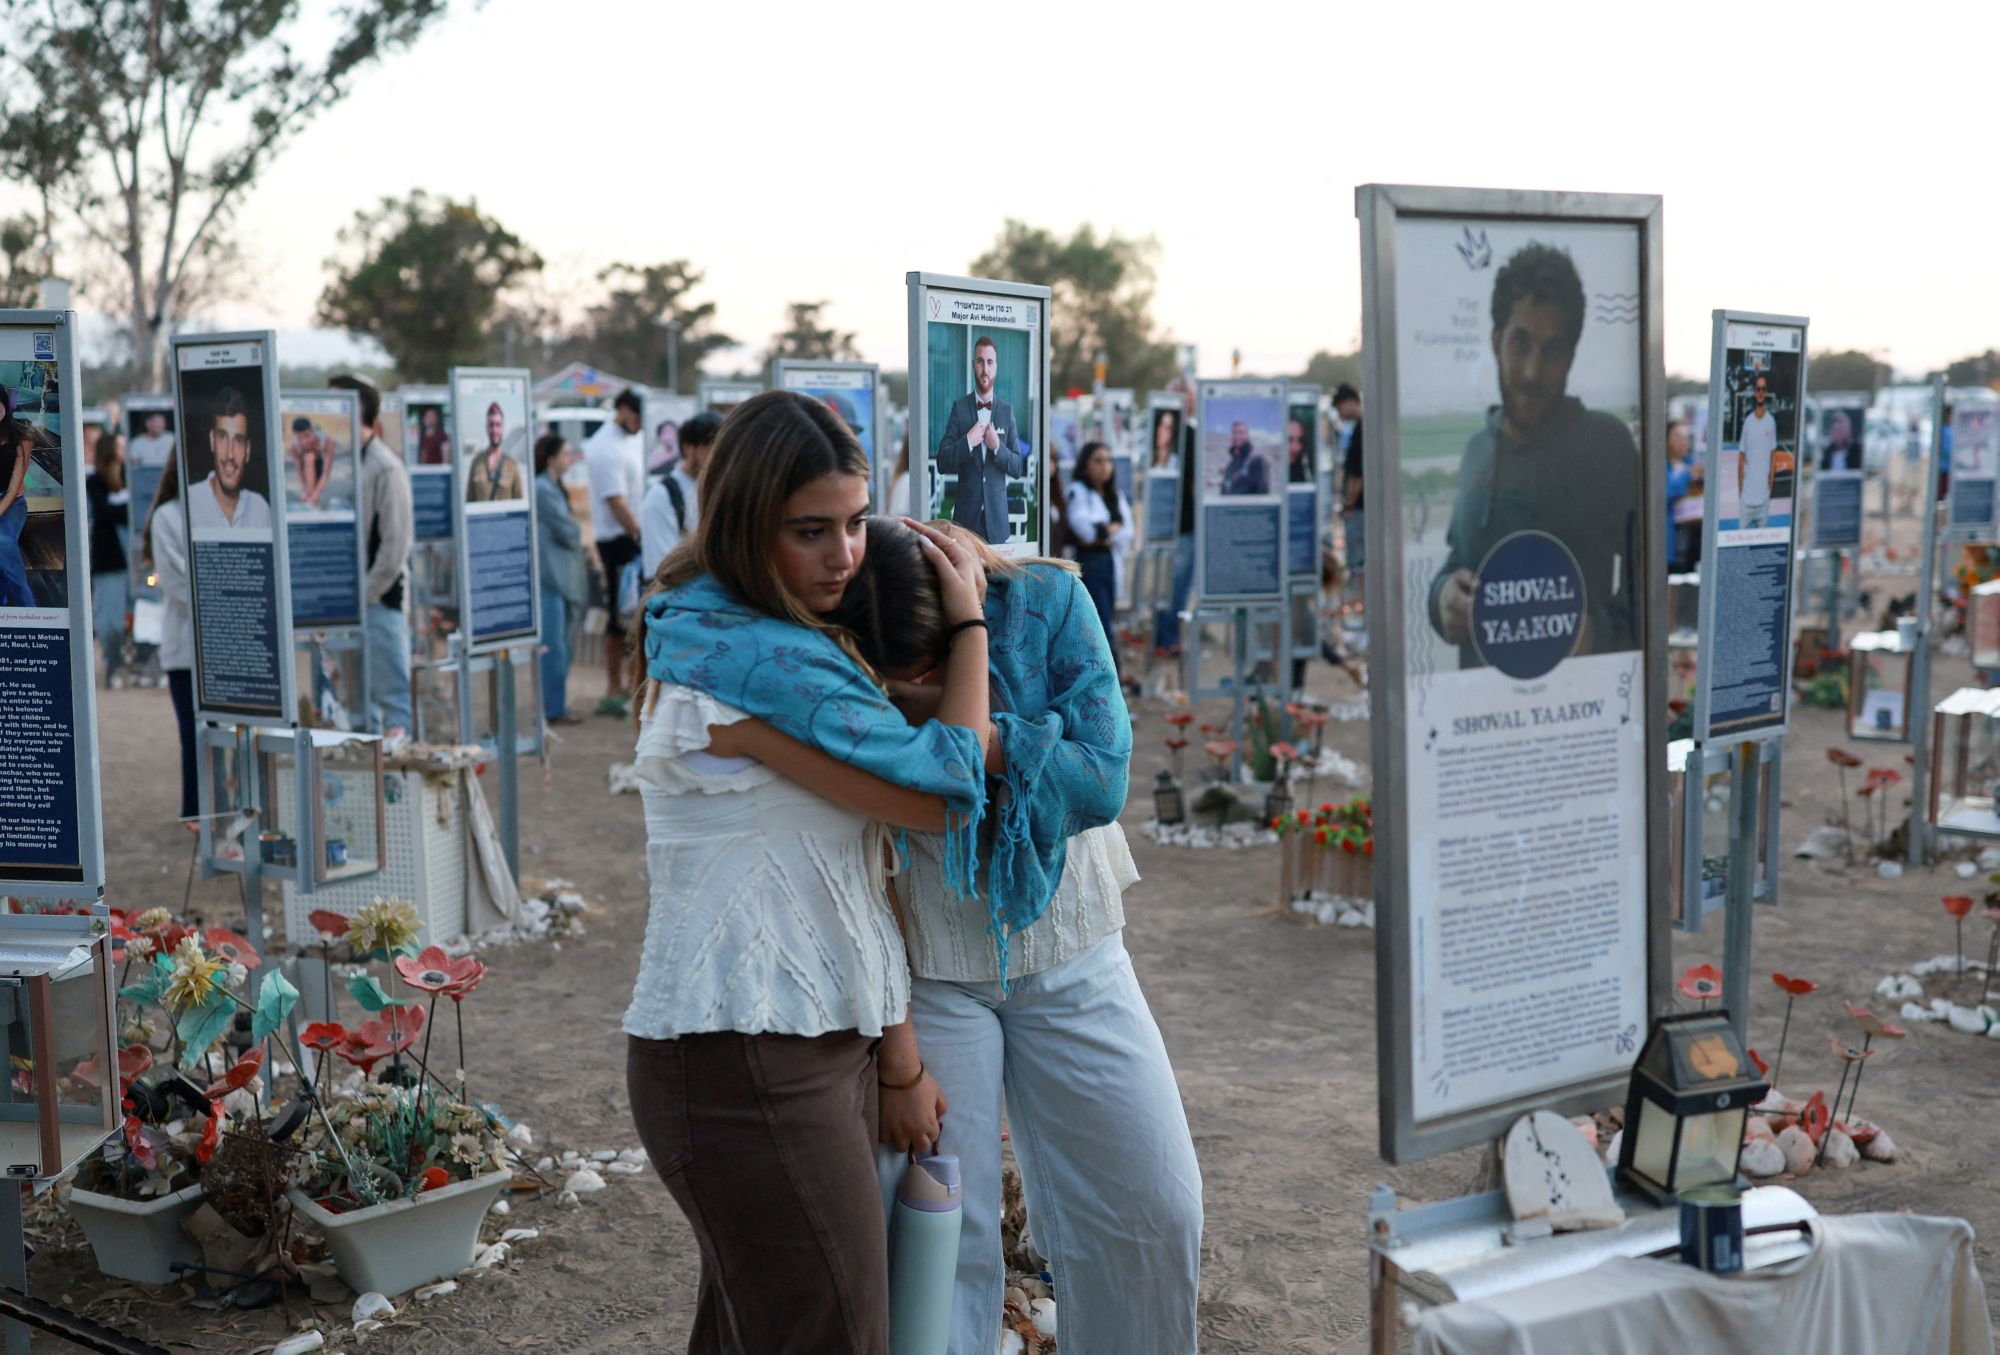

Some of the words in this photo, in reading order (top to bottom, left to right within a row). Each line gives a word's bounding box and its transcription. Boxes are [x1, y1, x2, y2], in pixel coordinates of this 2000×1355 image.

[952, 312, 968, 320] Major
[1484, 576, 1574, 606] SHOVAL
[1482, 613, 1578, 644] YAAKOV
[1452, 711, 1527, 738] SHOVAL
[1531, 700, 1605, 728] YAAKOV
